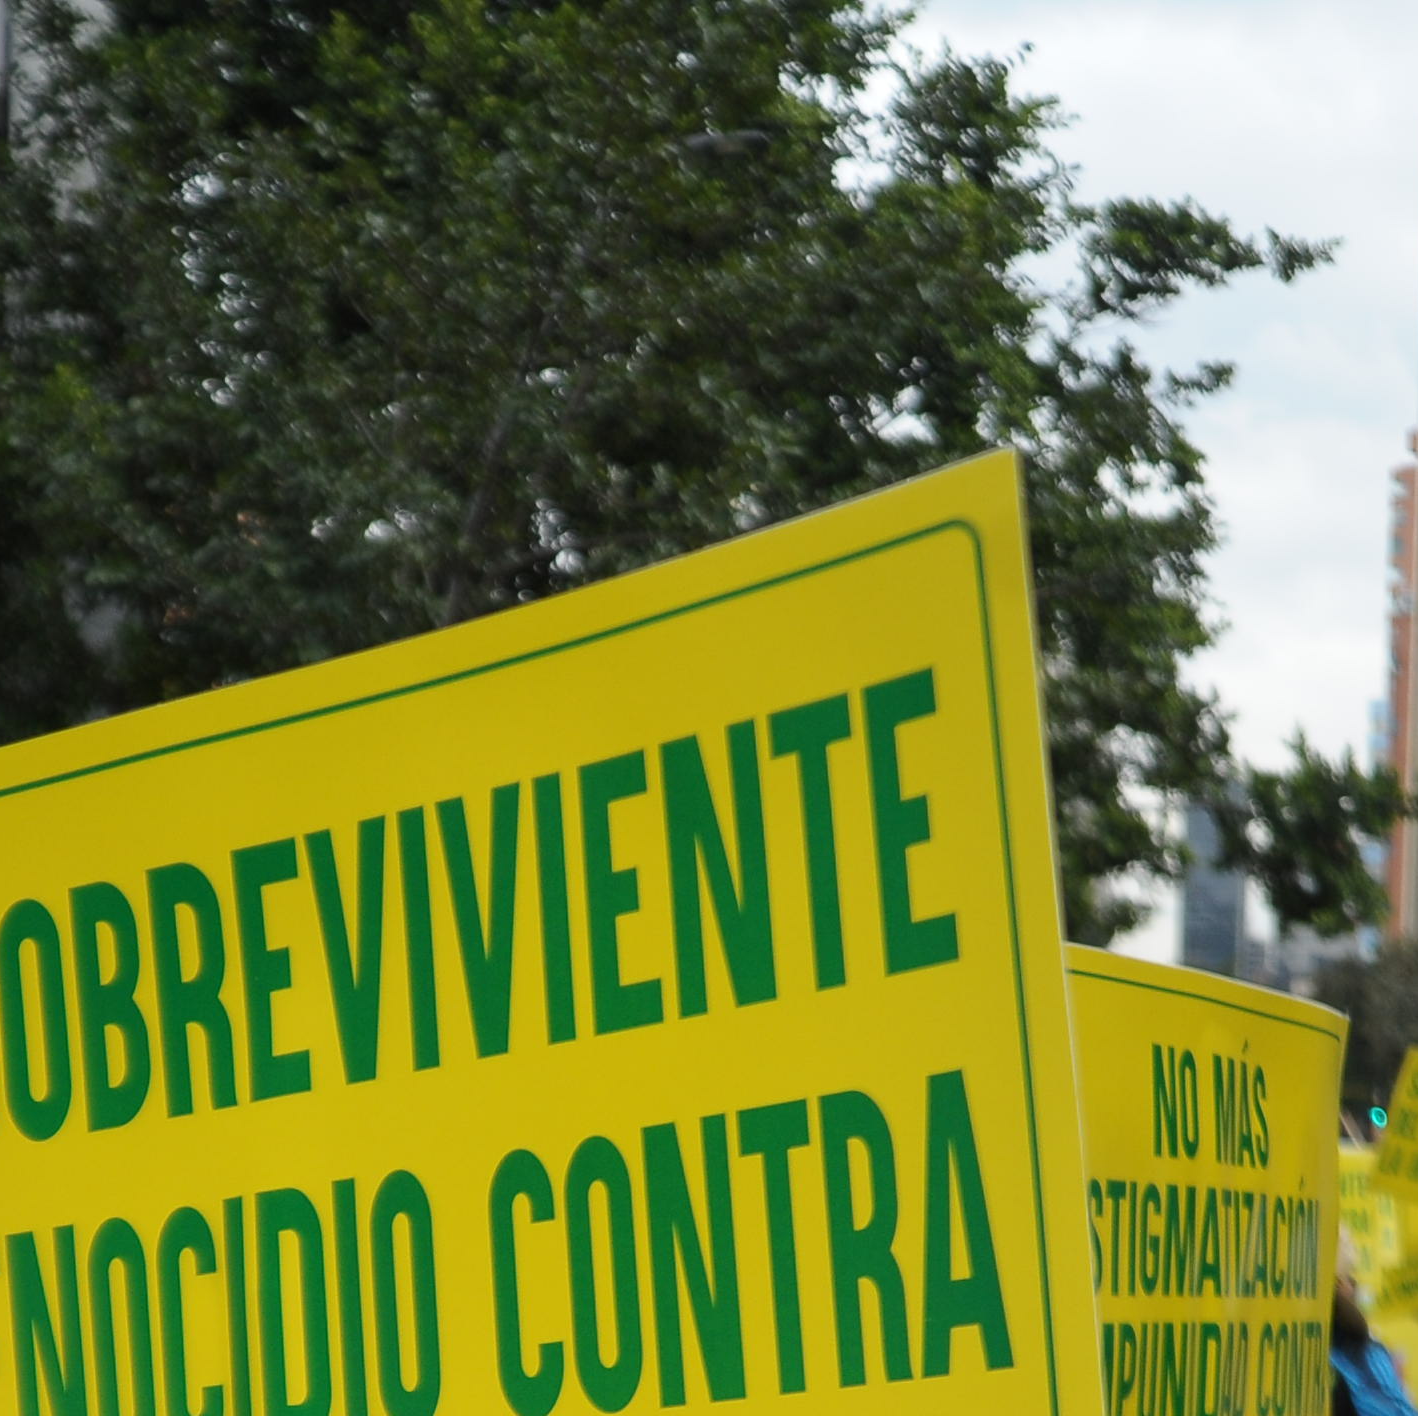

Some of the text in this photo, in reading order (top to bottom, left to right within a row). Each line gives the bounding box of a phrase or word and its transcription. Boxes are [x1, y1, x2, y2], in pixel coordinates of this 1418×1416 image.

[1151, 1043, 1200, 1159] NO
[1212, 1039, 1270, 1169] MÁS
[1087, 1175, 1319, 1299] STIGMATIZACIÓN
